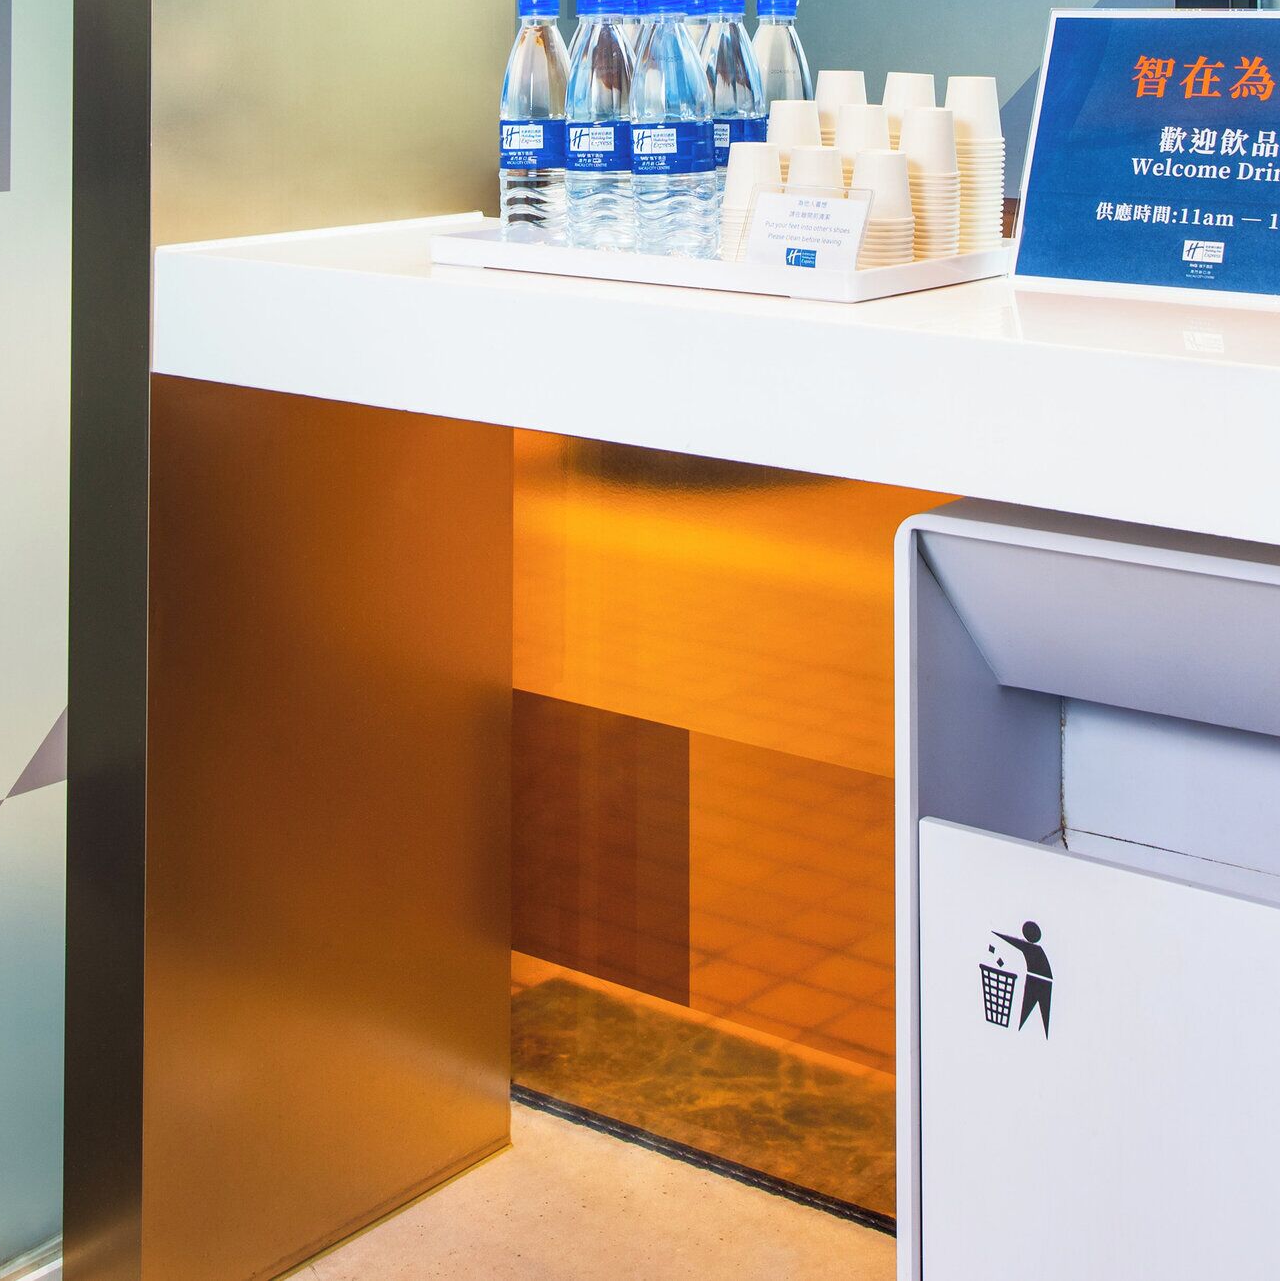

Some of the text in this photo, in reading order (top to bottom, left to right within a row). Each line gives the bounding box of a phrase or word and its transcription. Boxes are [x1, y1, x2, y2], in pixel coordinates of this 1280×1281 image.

[1158, 126, 1280, 158] 歡迎飲品
[1131, 157, 1231, 181] Welcome
[833, 226, 850, 234] shoes
[822, 237, 841, 246] leaving
